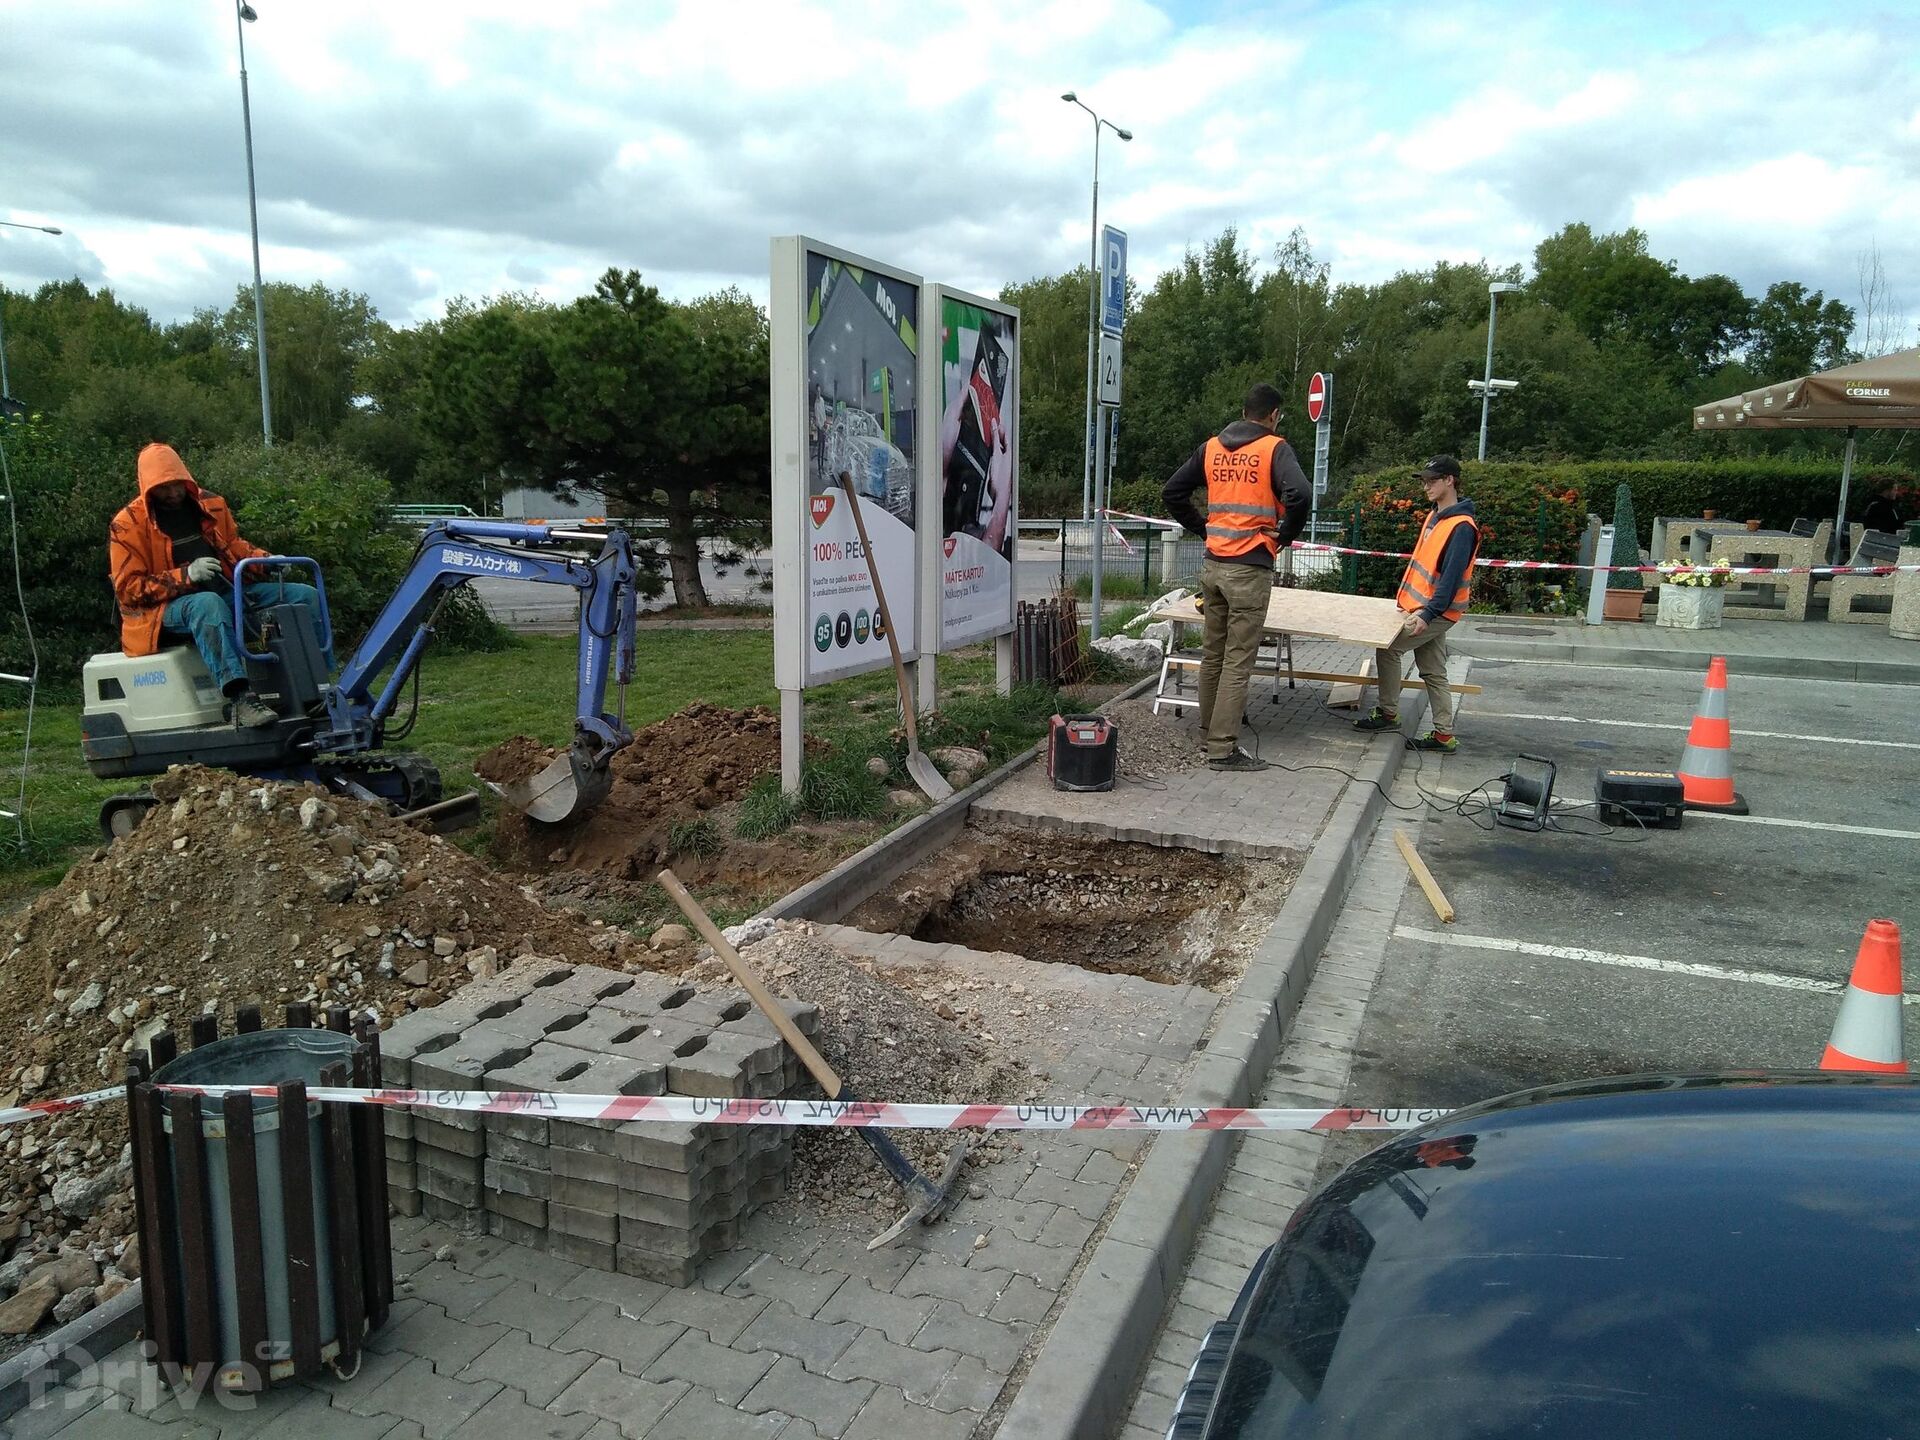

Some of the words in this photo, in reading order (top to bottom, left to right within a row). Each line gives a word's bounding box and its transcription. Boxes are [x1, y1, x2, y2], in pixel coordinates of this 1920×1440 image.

[1108, 241, 1121, 298] P
[876, 280, 897, 326] MOL
[1846, 388, 1890, 396] CORNER
[1213, 453, 1260, 467] ENERG
[1212, 469, 1258, 484] SERVIS
[812, 499, 827, 513] MOL
[813, 542, 843, 562] 100%
[840, 621, 847, 637] D
[856, 616, 868, 630] 100
[874, 613, 882, 629] D
[817, 623, 830, 643] 95
